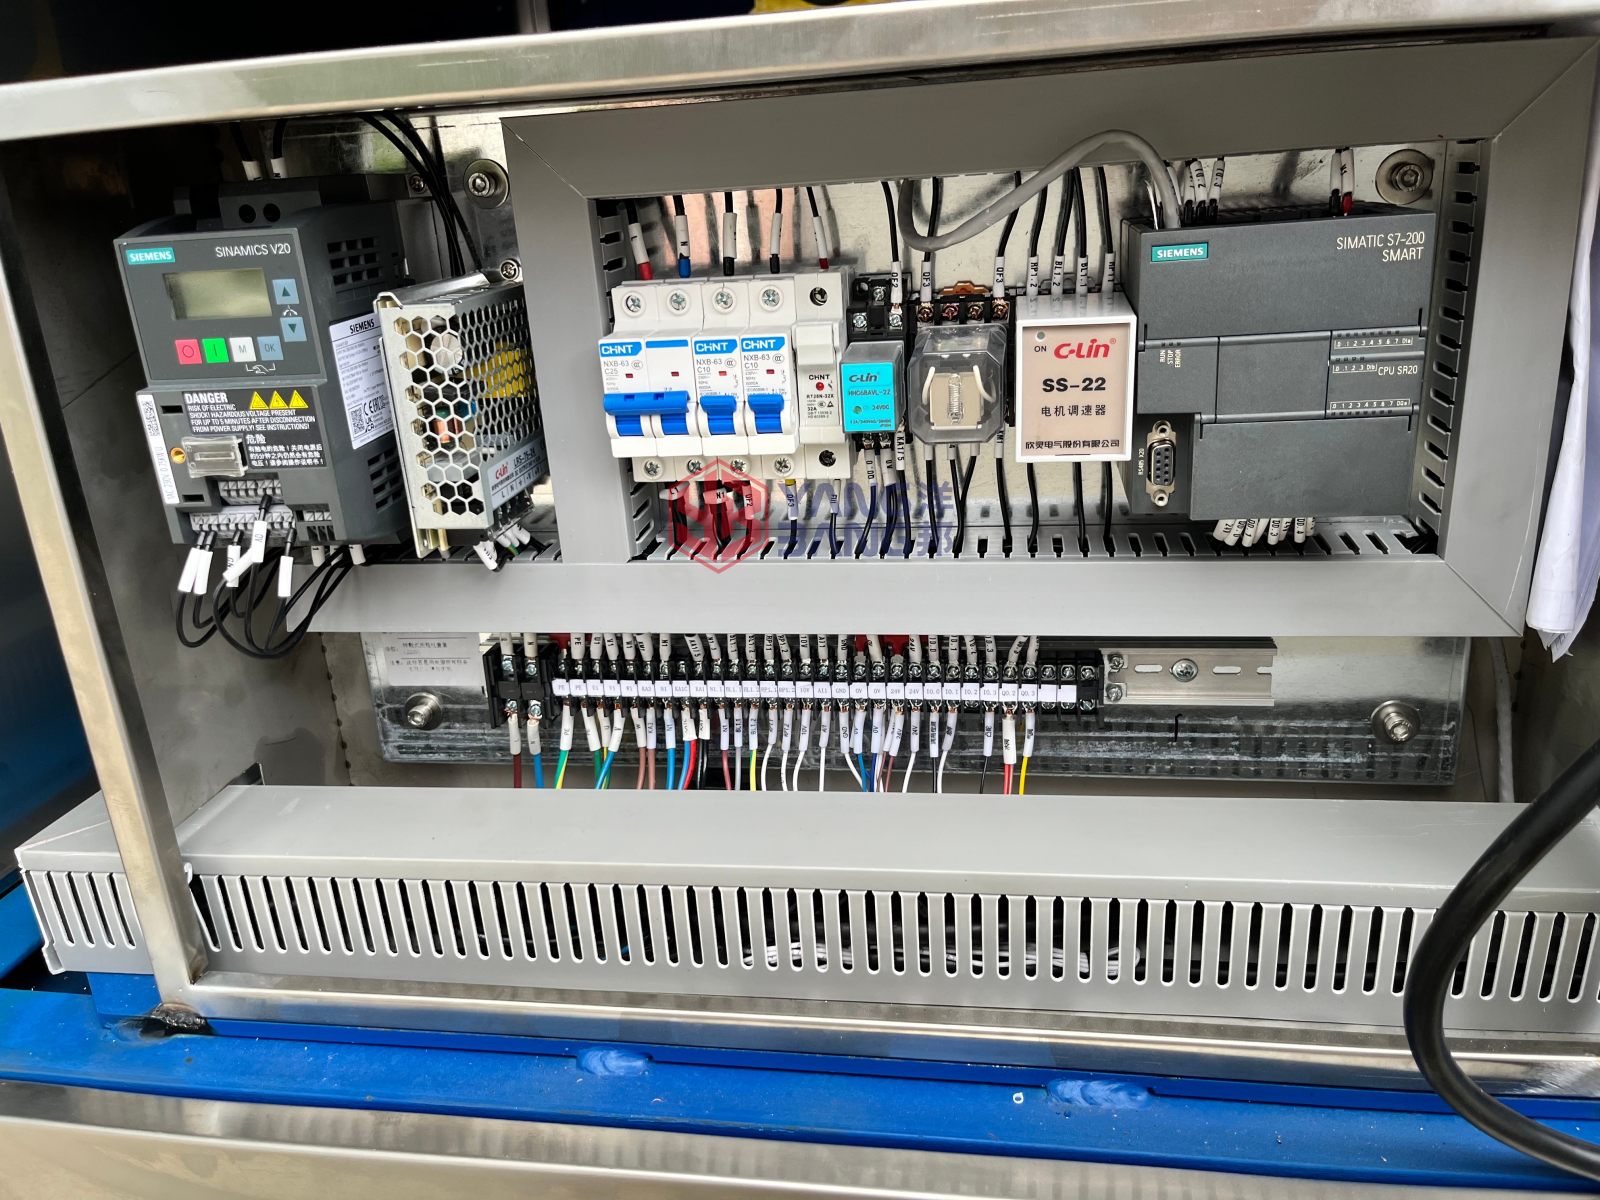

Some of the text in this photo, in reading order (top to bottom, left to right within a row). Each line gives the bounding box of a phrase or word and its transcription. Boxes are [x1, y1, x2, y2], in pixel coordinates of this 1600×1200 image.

[1336, 232, 1425, 250] SIMATIC S7-200
[215, 243, 291, 258] SINAMICS V20
[1157, 246, 1204, 258] SIEMENS
[1382, 247, 1424, 262] SMART
[129, 251, 172, 262] SIEMENS
[350, 319, 375, 334] SIEMENS
[239, 345, 247, 353] M
[264, 344, 276, 352] OK
[602, 345, 632, 354] CHNT
[696, 342, 728, 352] CHNT
[743, 340, 776, 349] CHNT
[1378, 365, 1418, 376] CPU SR20
[1042, 377, 1106, 392] SS-22
[184, 392, 228, 404] DANGER
[1042, 405, 1106, 416] 电机调速器
[1026, 440, 1120, 450] 欣灵电气股份有限公司
